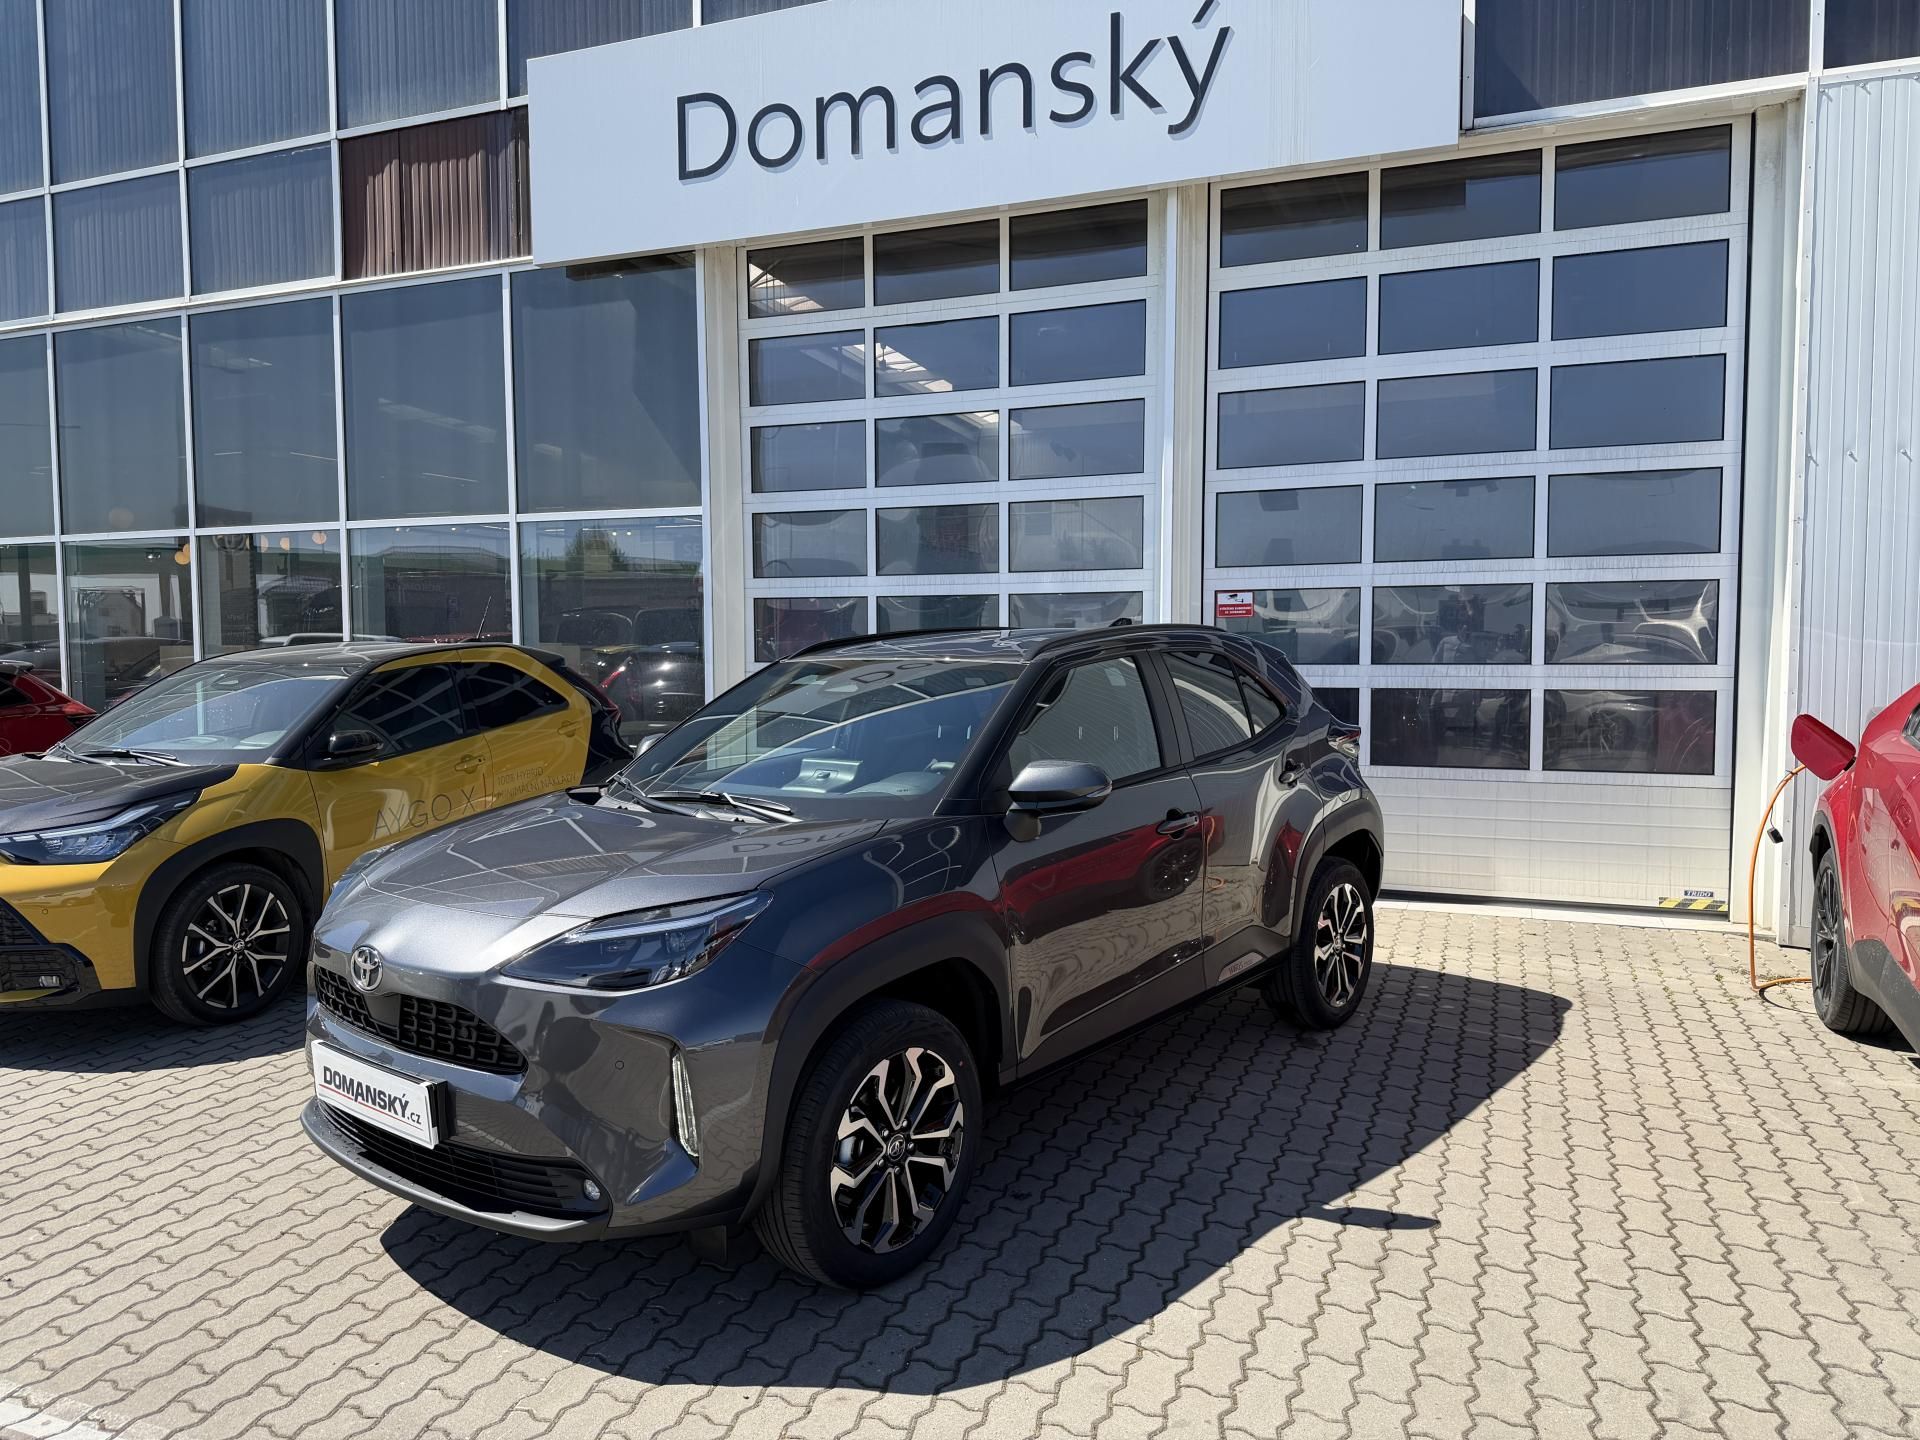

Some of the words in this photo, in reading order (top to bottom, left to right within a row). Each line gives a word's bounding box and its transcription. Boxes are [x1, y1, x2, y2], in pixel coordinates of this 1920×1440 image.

[677, 0, 1231, 181] Domanský
[373, 793, 452, 840] AYGO
[460, 785, 476, 815] X
